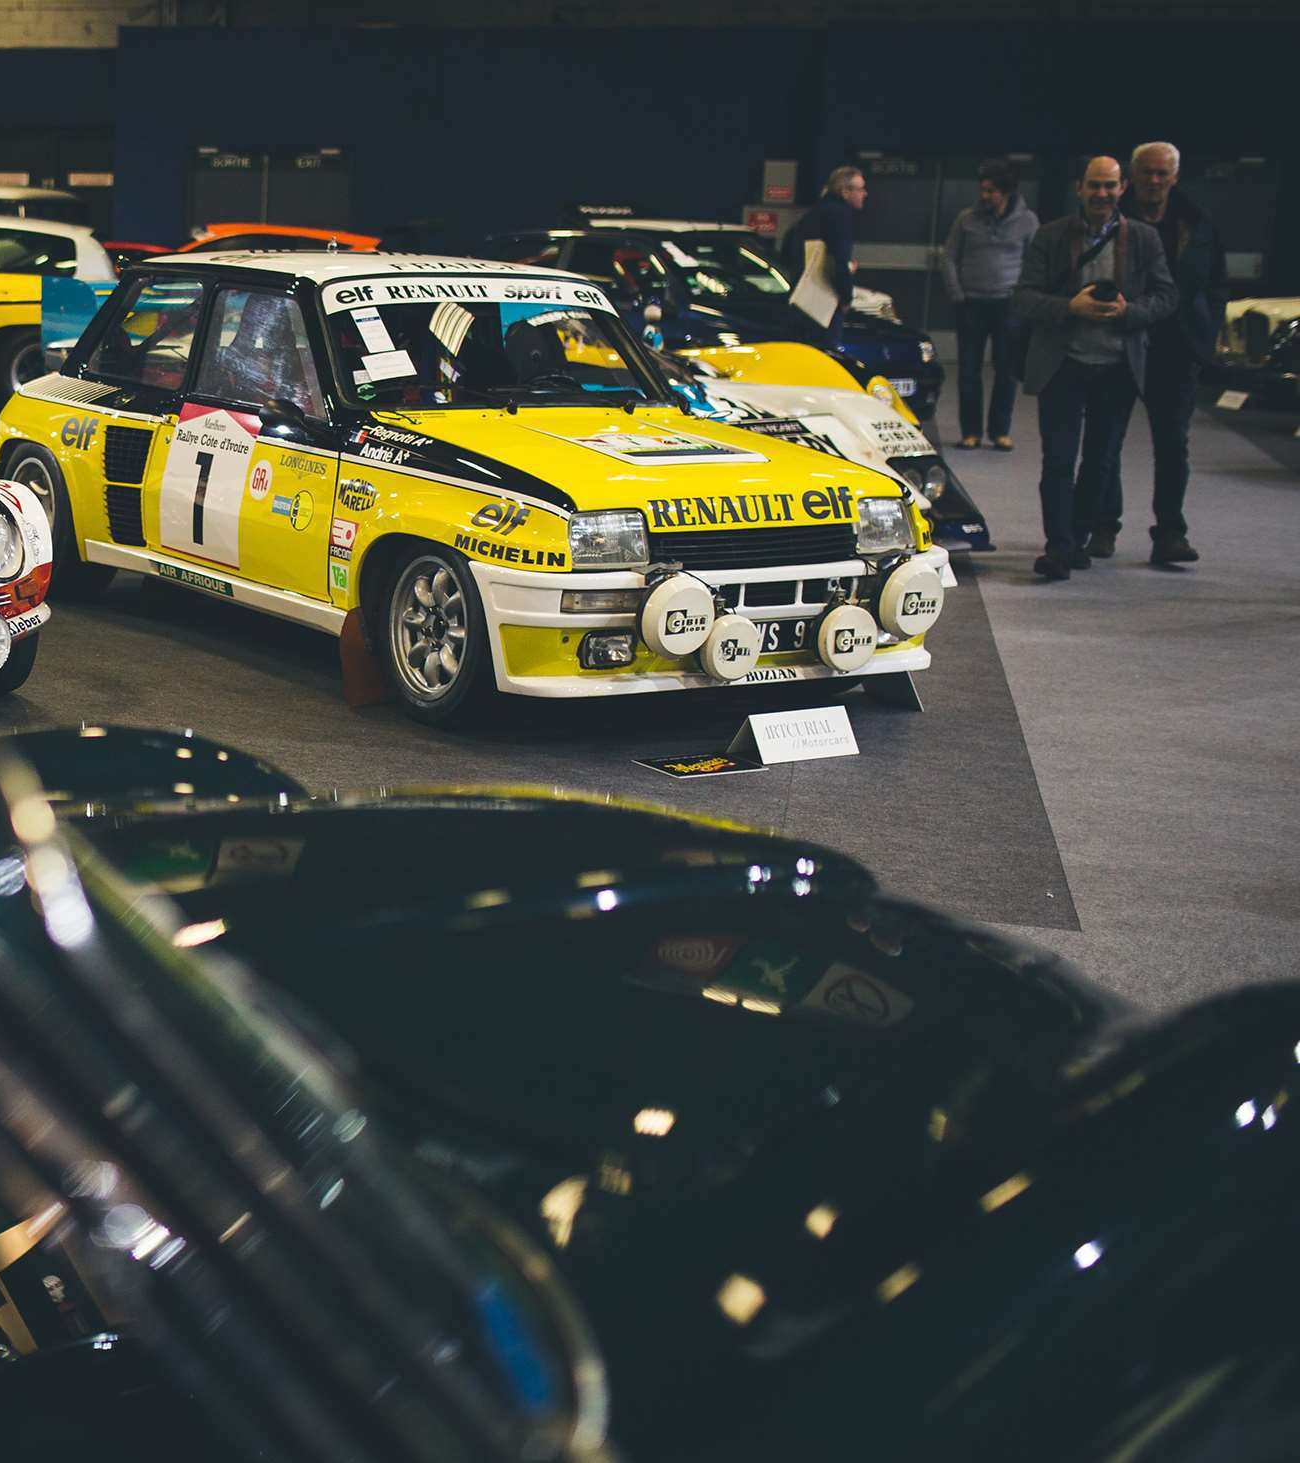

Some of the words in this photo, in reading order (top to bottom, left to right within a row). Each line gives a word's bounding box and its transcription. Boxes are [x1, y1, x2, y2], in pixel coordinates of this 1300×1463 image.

[335, 285, 374, 304] elf
[385, 284, 490, 299] RENAULT
[503, 284, 562, 300] sport
[573, 289, 602, 307] elf
[61, 415, 100, 451] elf
[176, 429, 199, 446] Rallye
[359, 442, 394, 463] Andrié
[279, 454, 327, 476] LONGINES
[192, 450, 215, 546] 1
[647, 493, 794, 529] RENAULT
[801, 485, 853, 520] elf
[470, 502, 531, 536] elf
[453, 533, 566, 567] MICHELIN
[159, 563, 178, 578] AIR
[180, 570, 227, 593] AFRIQUE
[7, 613, 42, 636] Kleber
[724, 646, 751, 657] CIBI
[764, 718, 836, 740] ARTCURIAL
